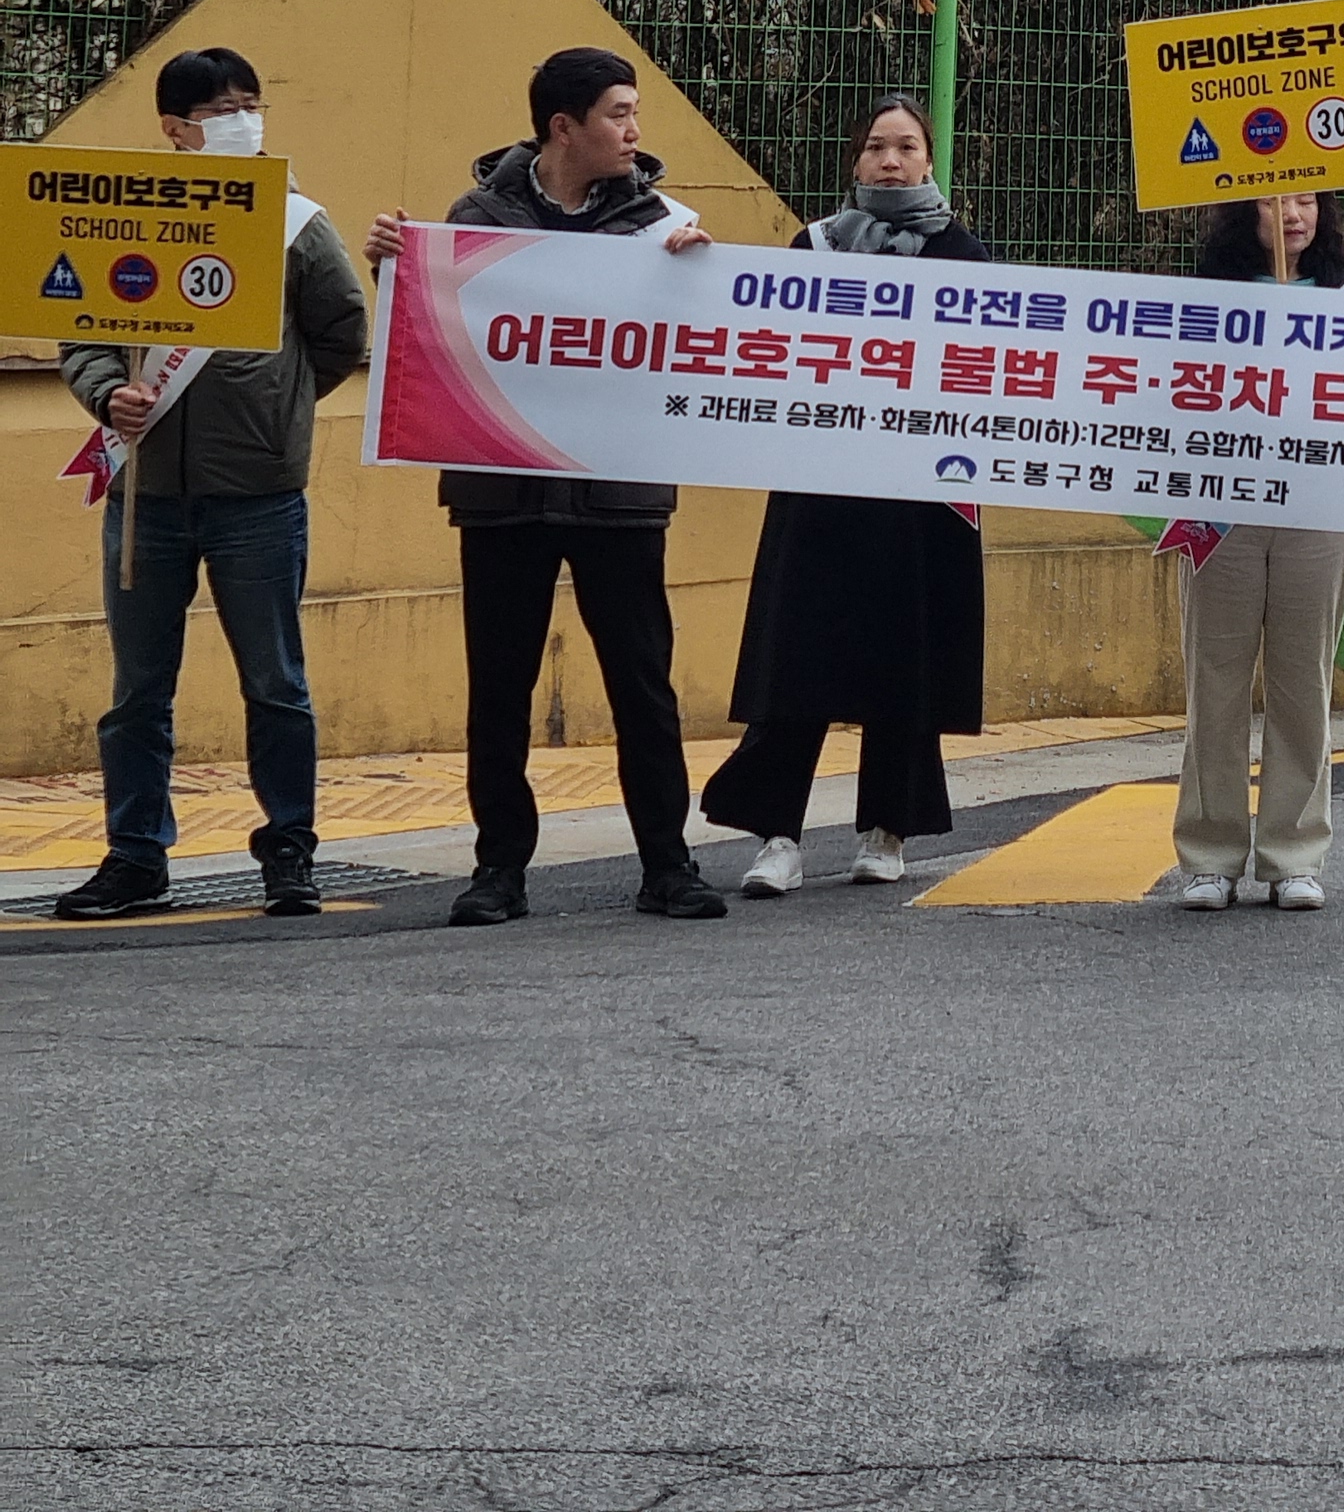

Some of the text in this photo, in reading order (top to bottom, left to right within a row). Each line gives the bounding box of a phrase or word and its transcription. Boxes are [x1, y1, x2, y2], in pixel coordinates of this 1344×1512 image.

[1191, 66, 1336, 103] SCHOOL ZONE
[28, 171, 255, 212] 어린이보호구역
[60, 216, 217, 245] SCHOOL ZONE
[188, 265, 224, 298] 30
[732, 271, 914, 321] 아이들의
[934, 285, 1068, 333] 안전을
[1087, 298, 1266, 348] 어른들이
[487, 313, 915, 390] 어린이보호구역
[939, 341, 1058, 402] 불법
[697, 394, 777, 426] 과태료
[988, 458, 1290, 506] 도봉구청 교통지도과
